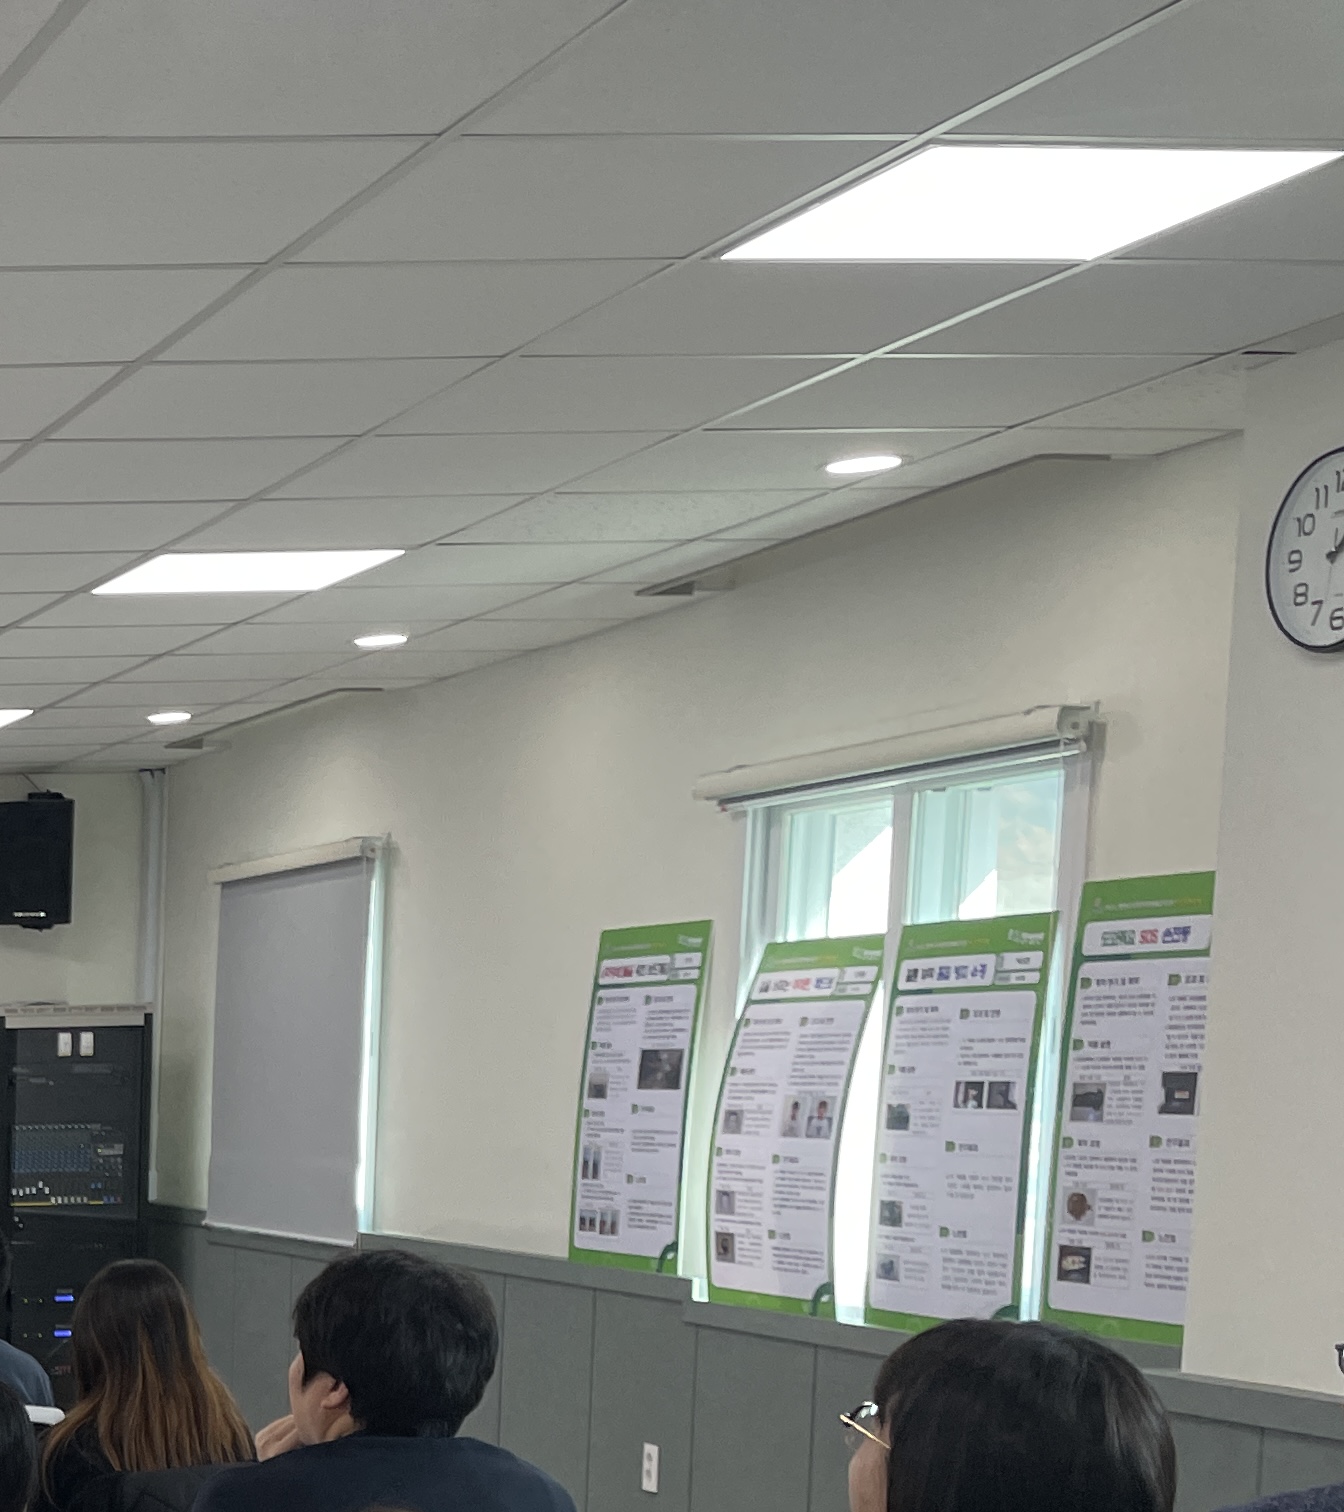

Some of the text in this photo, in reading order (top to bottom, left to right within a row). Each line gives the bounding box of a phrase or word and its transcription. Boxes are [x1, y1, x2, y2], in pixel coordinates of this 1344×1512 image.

[1315, 484, 1329, 510] 11
[1296, 513, 1315, 537] 10
[1288, 549, 1303, 573] 9
[1293, 582, 1309, 606] 8
[1311, 599, 1323, 626] 7
[1329, 606, 1344, 631] 6
